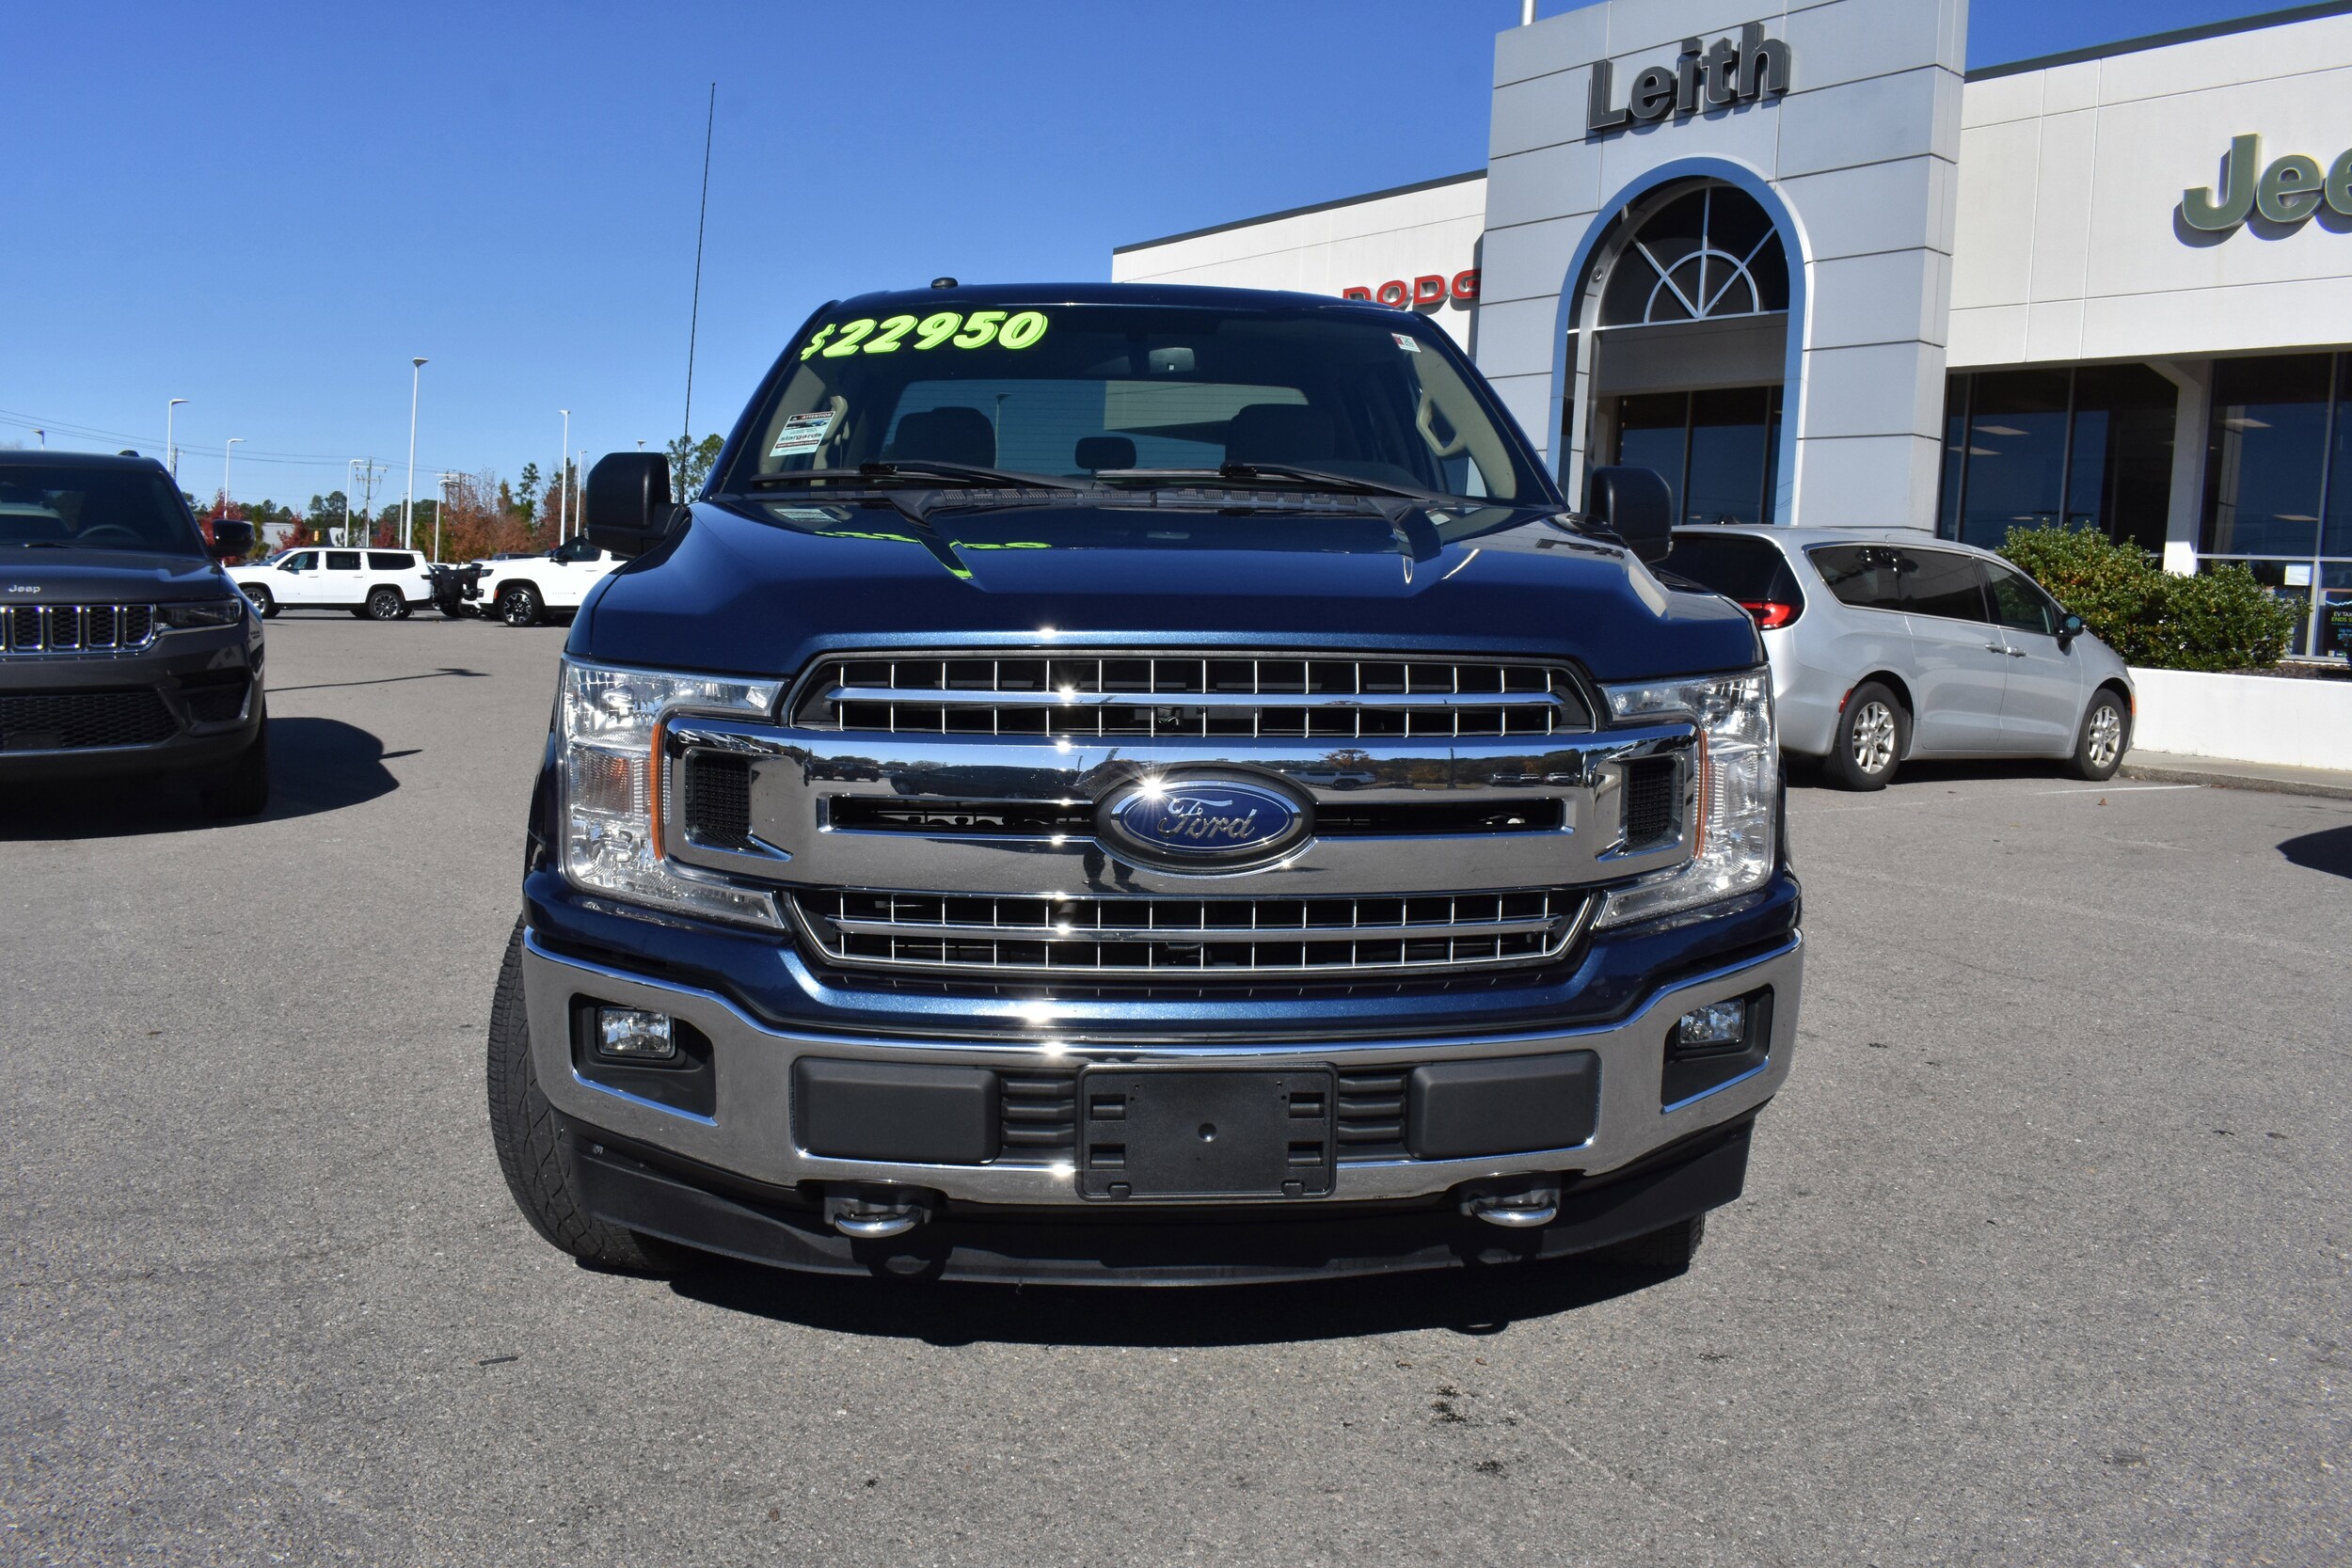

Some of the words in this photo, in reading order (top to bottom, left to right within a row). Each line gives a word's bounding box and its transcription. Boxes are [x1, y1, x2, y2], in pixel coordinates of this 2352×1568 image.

[1587, 22, 1791, 131] Leith
[800, 310, 1049, 361] $22950
[8, 584, 41, 594] Jeep
[1157, 797, 1258, 839] Ford
